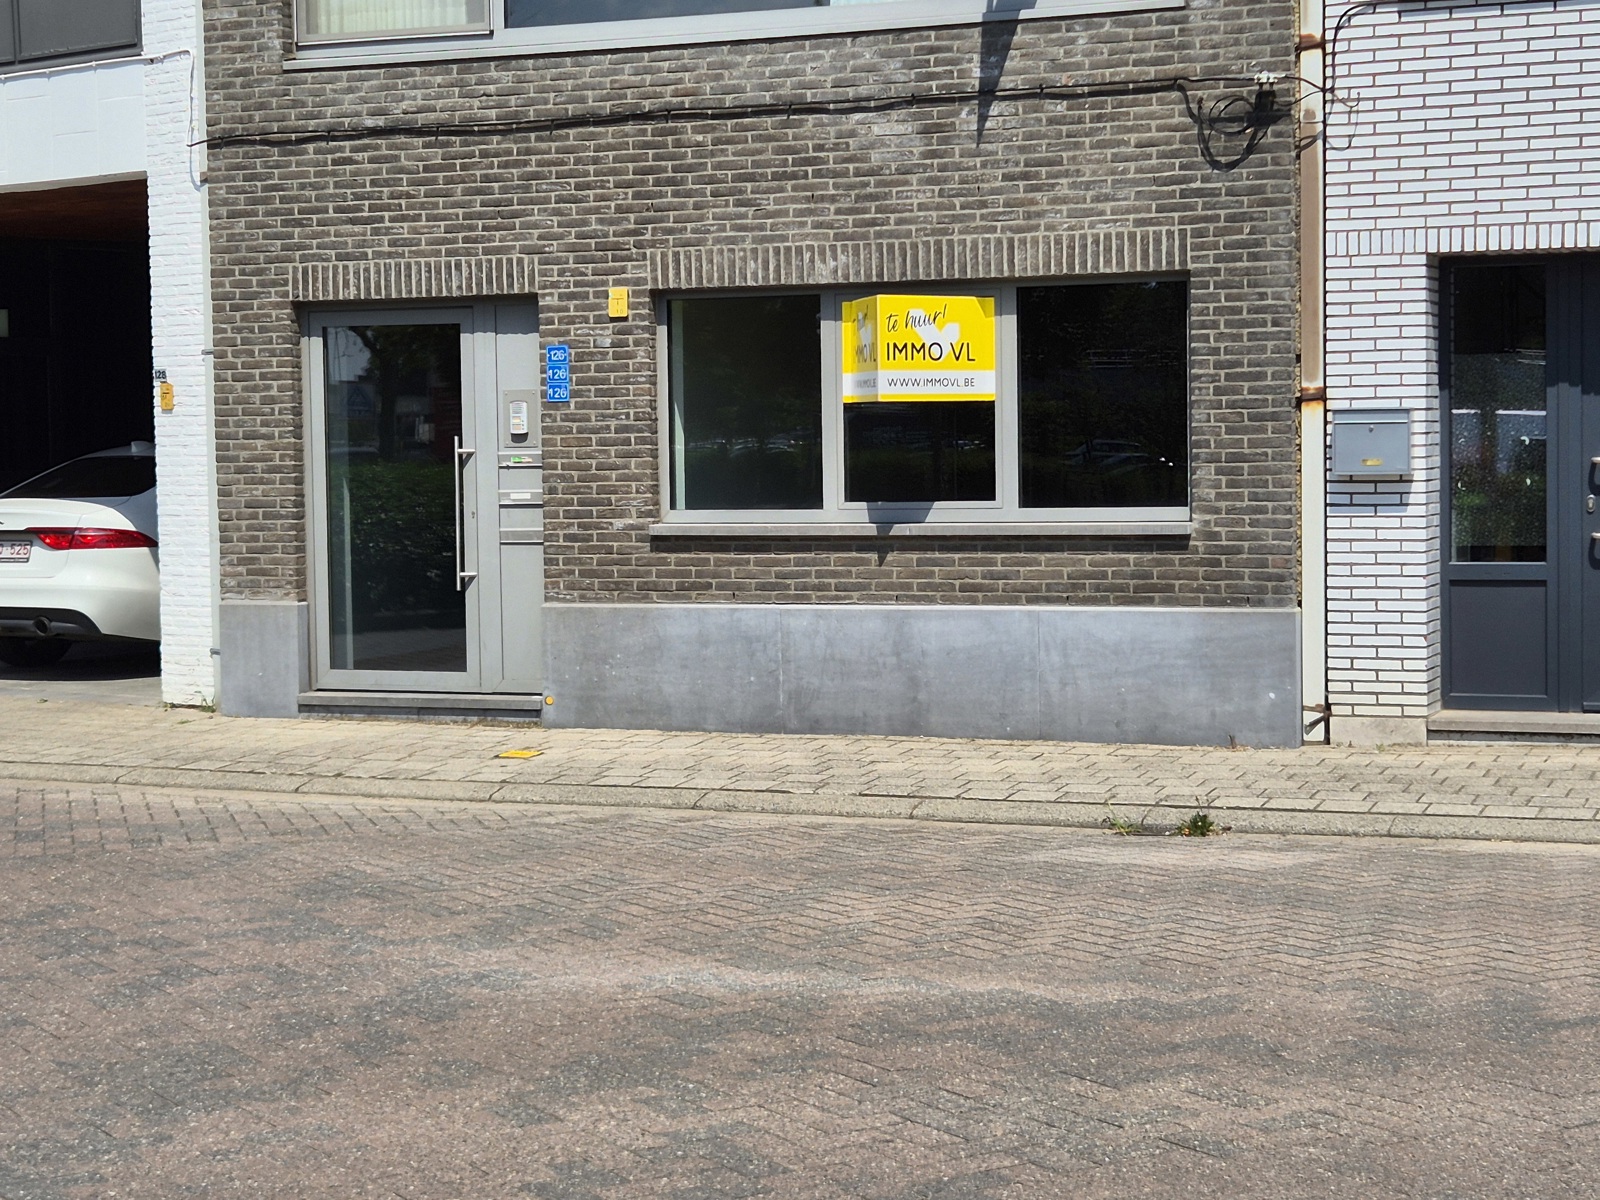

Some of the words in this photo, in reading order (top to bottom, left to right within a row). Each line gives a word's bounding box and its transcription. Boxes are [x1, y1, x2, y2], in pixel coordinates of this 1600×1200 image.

[886, 313, 899, 332] te
[550, 349, 565, 361] 126
[886, 341, 943, 361] IMMO
[949, 341, 976, 361] VL
[549, 368, 567, 380] 126
[887, 377, 975, 387] WWW.IMMOVL.BE
[550, 387, 567, 398] 126
